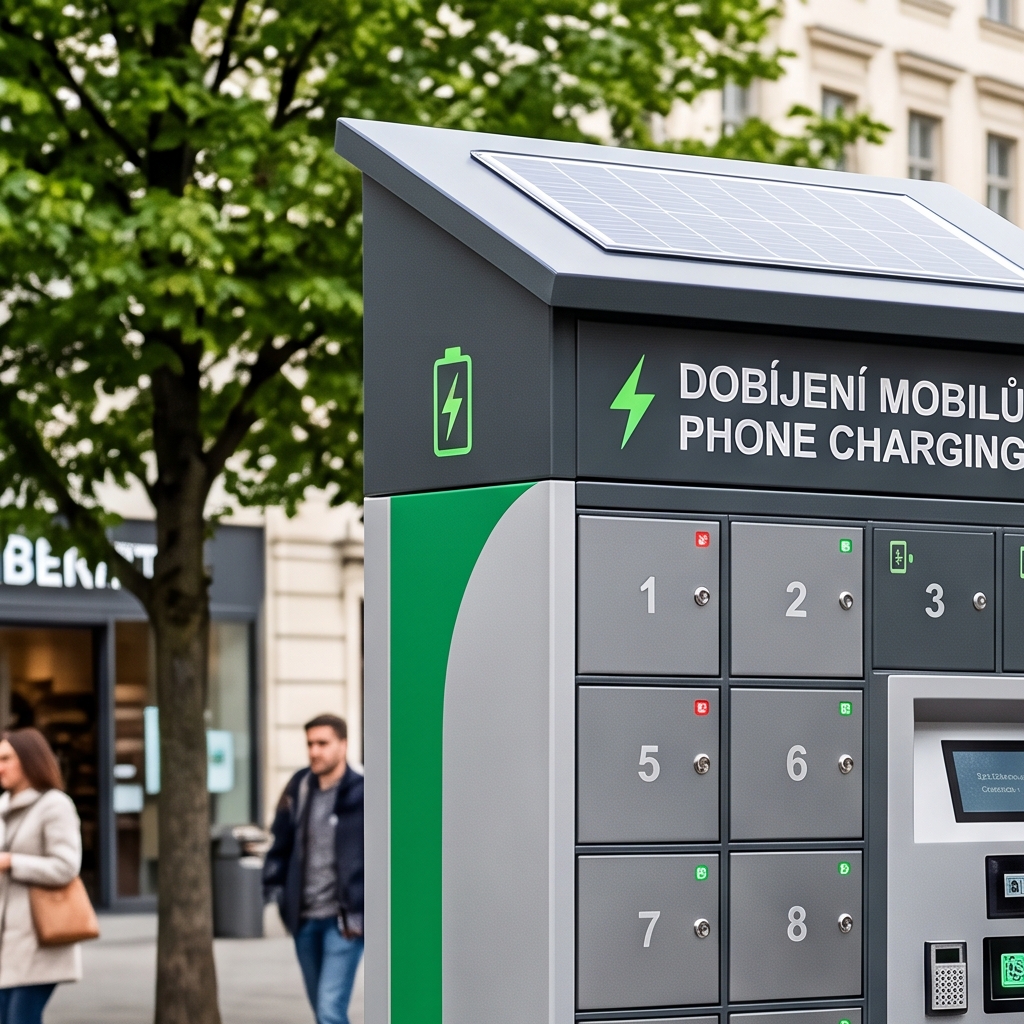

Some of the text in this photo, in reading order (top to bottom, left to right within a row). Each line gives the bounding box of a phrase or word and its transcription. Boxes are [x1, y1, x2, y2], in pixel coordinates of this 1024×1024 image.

[680, 359, 1024, 423] DOBÍJENÍ MOBILŮ
[679, 414, 817, 459] PHONE
[639, 576, 656, 614] 1
[785, 581, 807, 618] 2
[925, 582, 945, 619] 3
[637, 745, 661, 783] 5
[786, 744, 808, 782] 6
[638, 910, 661, 948] 7
[786, 905, 808, 942] 8
